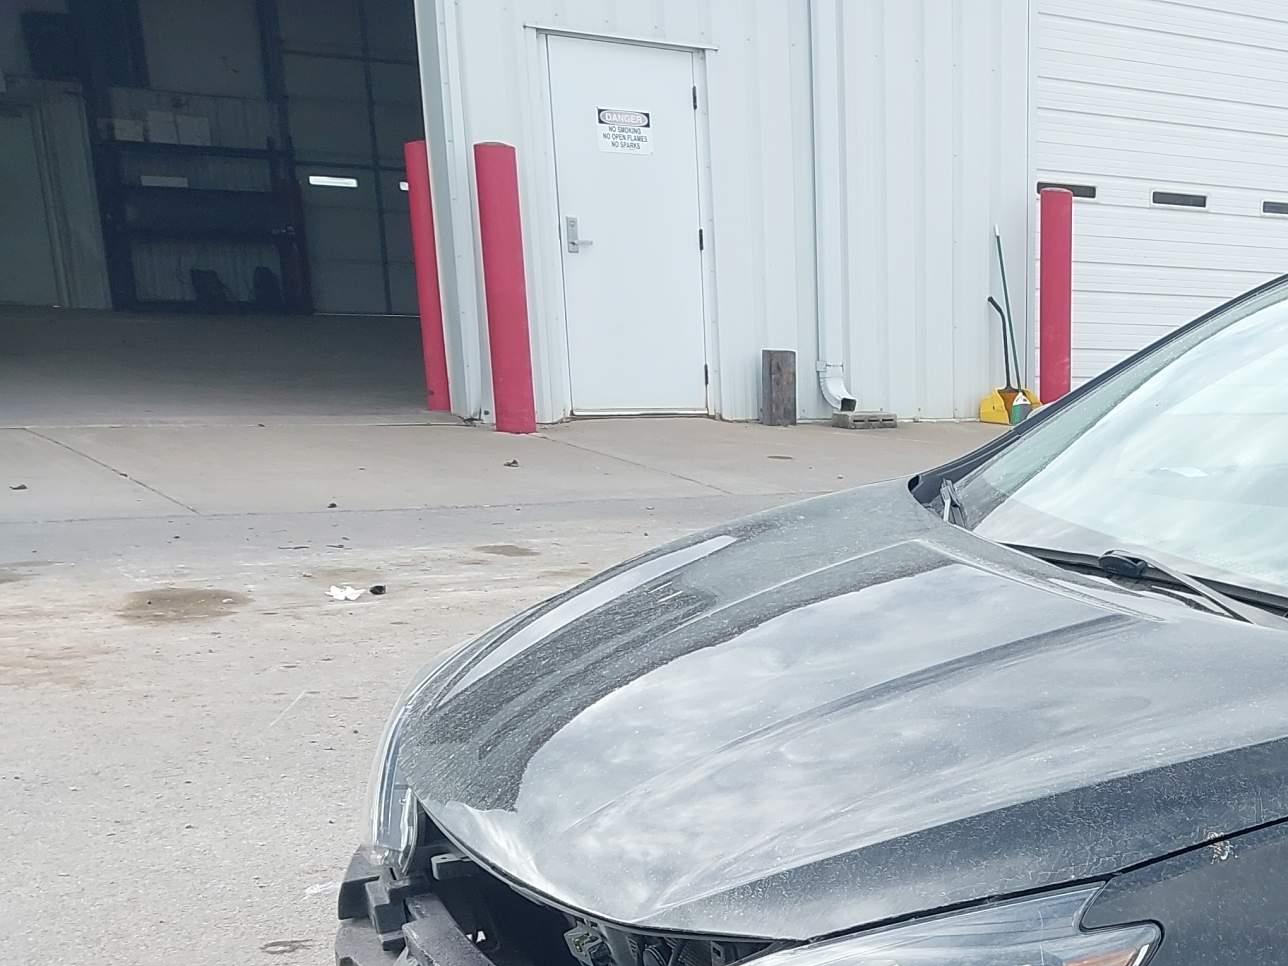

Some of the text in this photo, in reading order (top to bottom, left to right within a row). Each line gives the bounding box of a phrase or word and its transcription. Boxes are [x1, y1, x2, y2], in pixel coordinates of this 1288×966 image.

[605, 112, 642, 124] DANGER
[617, 127, 641, 135] SMOKING
[611, 133, 627, 141] OPEN
[627, 135, 648, 143] FLAMES
[620, 141, 641, 150] SPARKS
